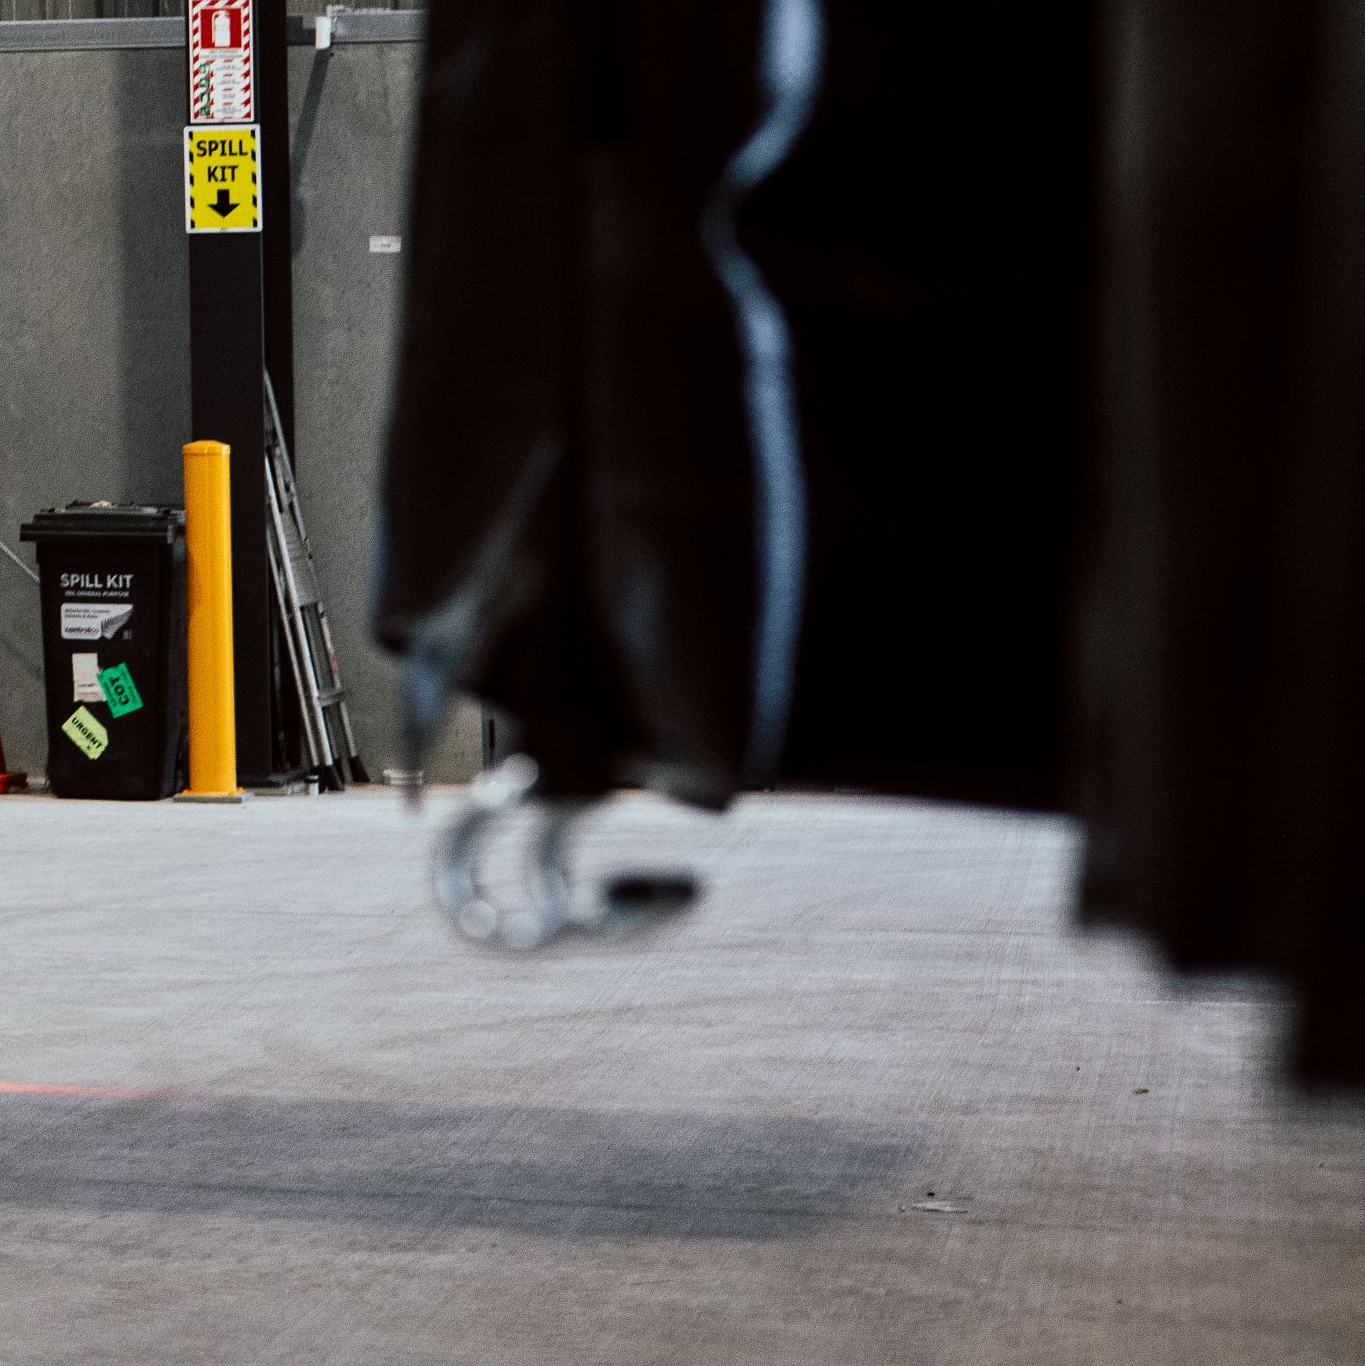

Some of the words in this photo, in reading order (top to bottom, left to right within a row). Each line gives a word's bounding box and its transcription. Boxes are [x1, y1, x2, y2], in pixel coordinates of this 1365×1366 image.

[196, 139, 248, 157] SPILL
[207, 165, 238, 183] KIT
[60, 572, 103, 589] SPILL
[106, 573, 134, 589] KIT
[71, 716, 103, 750] URGENT
